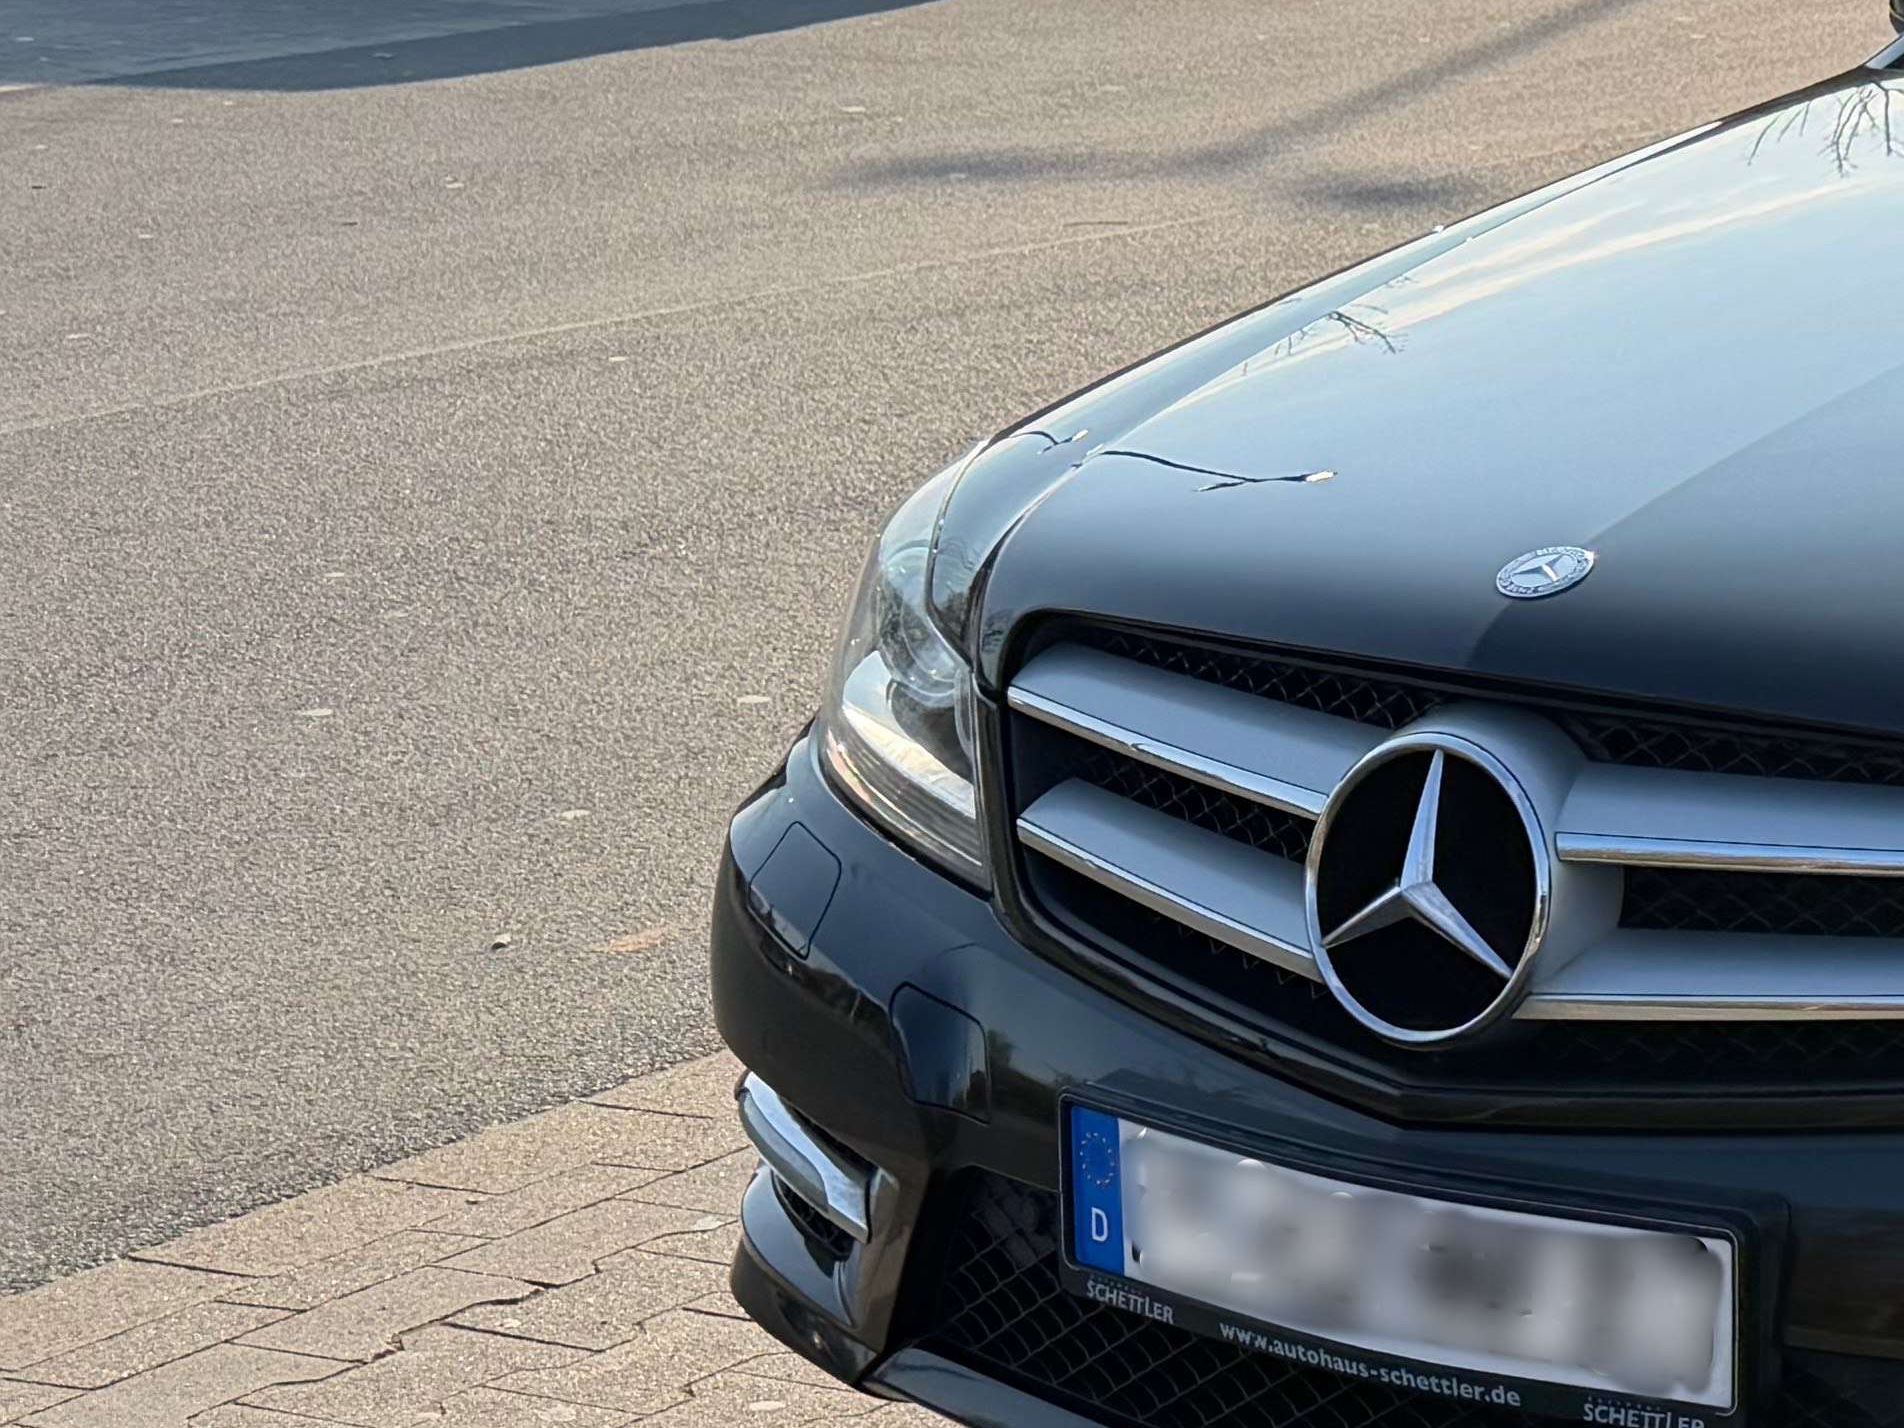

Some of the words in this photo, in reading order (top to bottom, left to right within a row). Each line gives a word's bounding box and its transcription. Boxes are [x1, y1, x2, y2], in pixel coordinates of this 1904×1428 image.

[1091, 1206, 1109, 1242] D
[1086, 1280, 1174, 1325] SCHETTLER
[1219, 1322, 1521, 1407] www.autohaus-schettler.de
